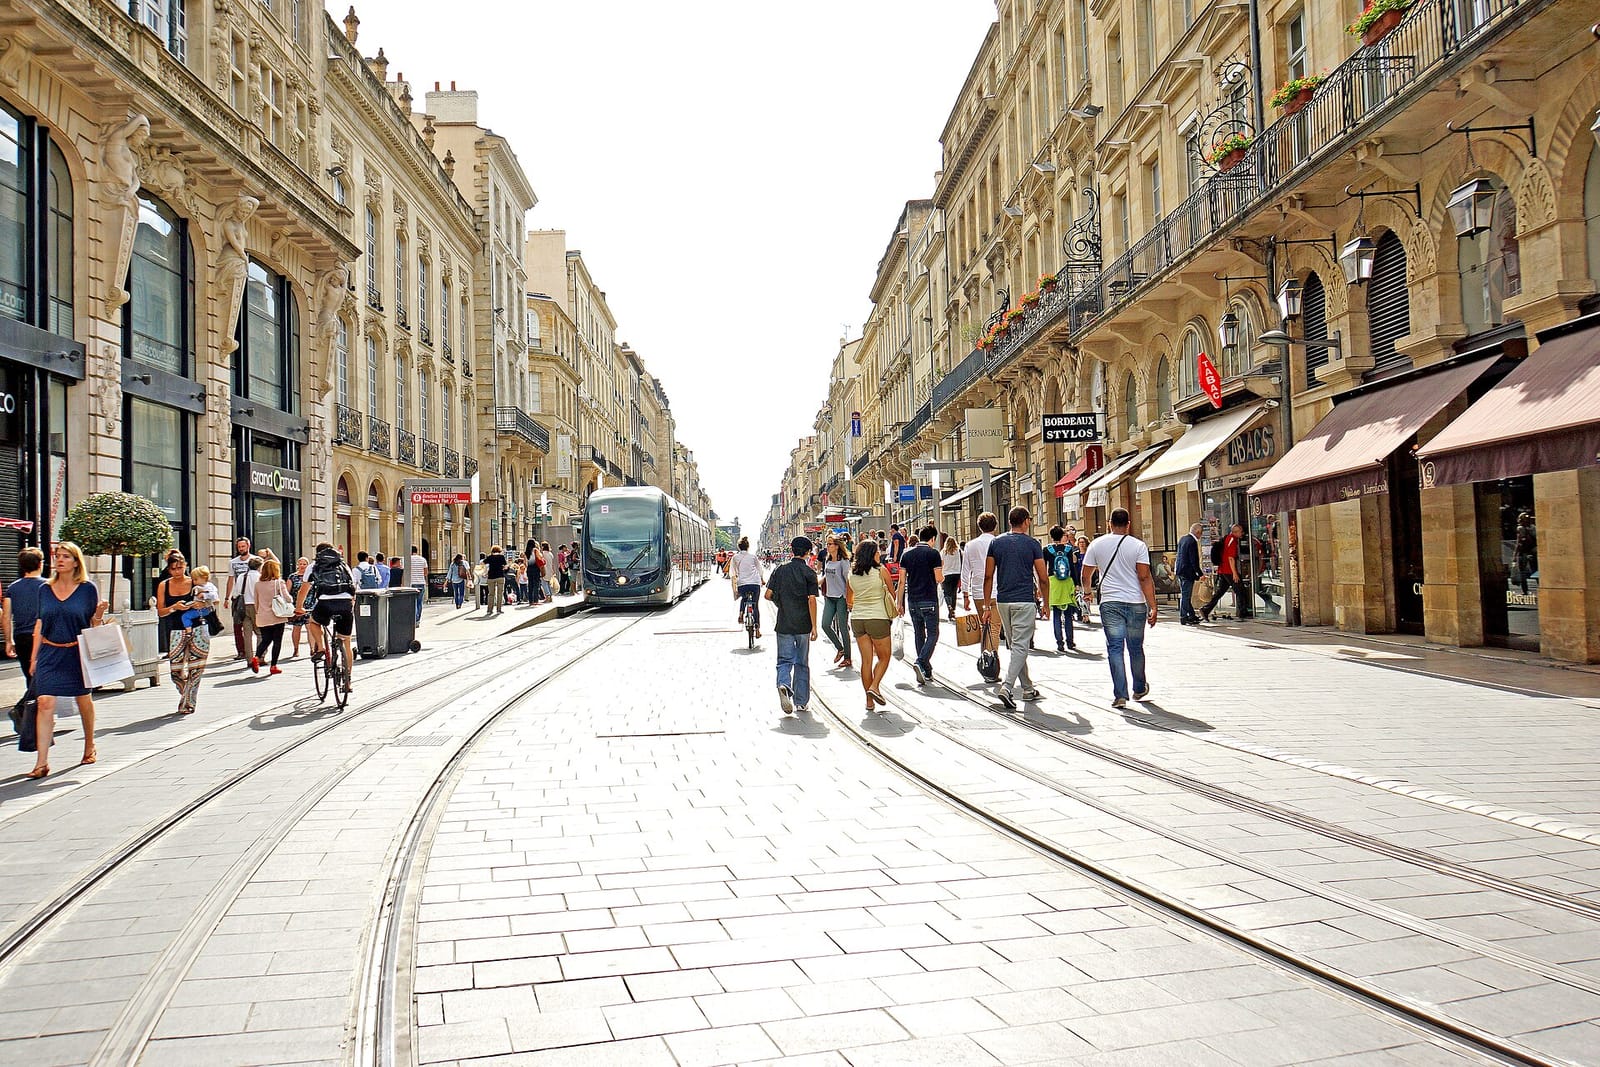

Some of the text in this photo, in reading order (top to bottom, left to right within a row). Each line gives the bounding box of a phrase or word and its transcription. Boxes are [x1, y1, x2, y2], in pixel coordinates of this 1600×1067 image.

[1202, 361, 1220, 399] TABAC
[1044, 416, 1095, 427] BORDEAUX
[1046, 429, 1094, 440] STYLOS
[1506, 590, 1537, 605] Biscuit
